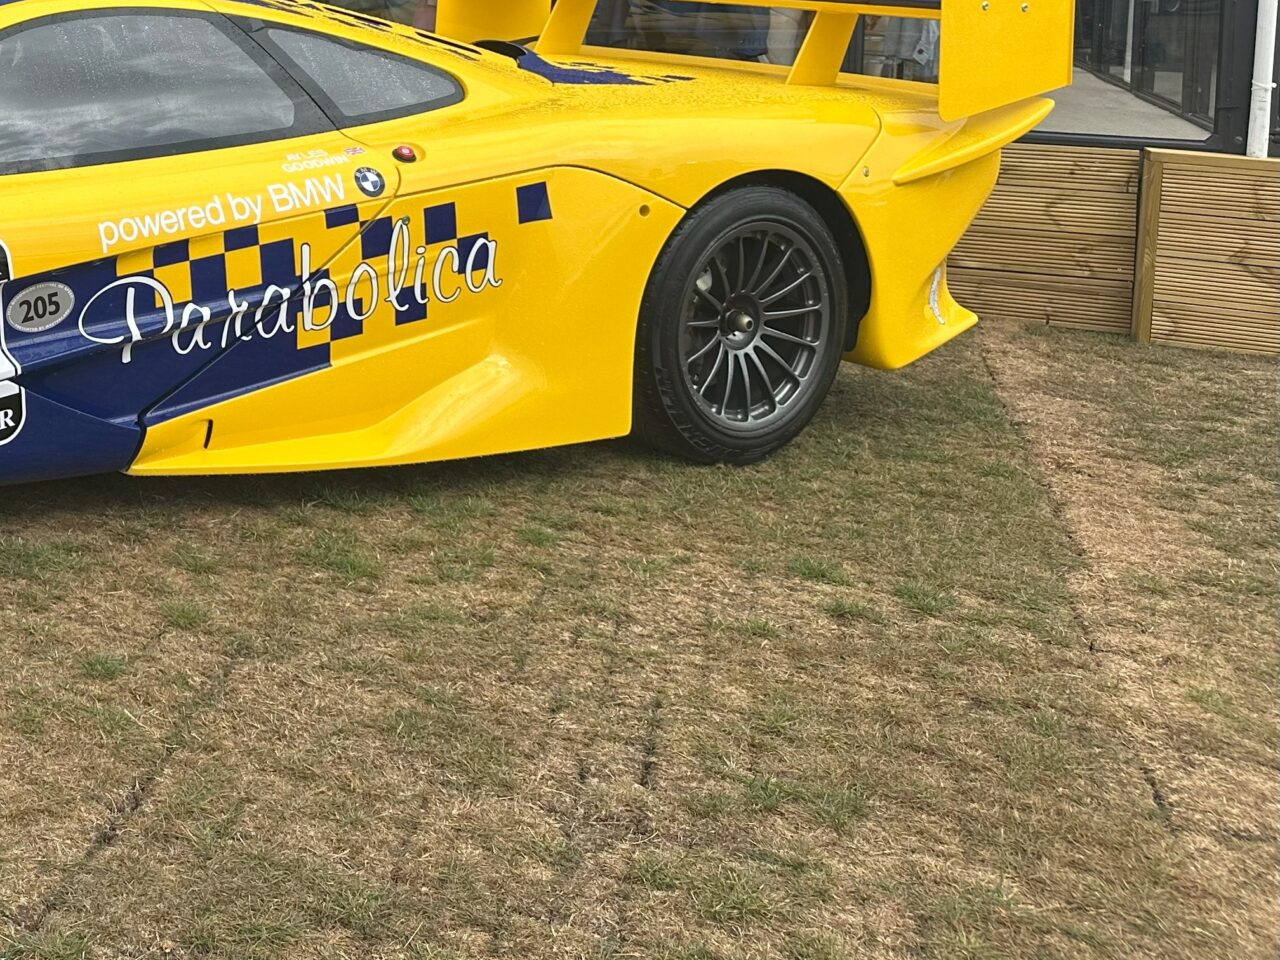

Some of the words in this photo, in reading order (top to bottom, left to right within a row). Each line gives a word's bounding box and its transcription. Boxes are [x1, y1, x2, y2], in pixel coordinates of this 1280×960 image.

[97, 195, 226, 253] powered
[227, 192, 263, 224] by
[266, 173, 346, 213] BMW
[19, 291, 61, 324] 205
[78, 215, 503, 364] Parabolica
